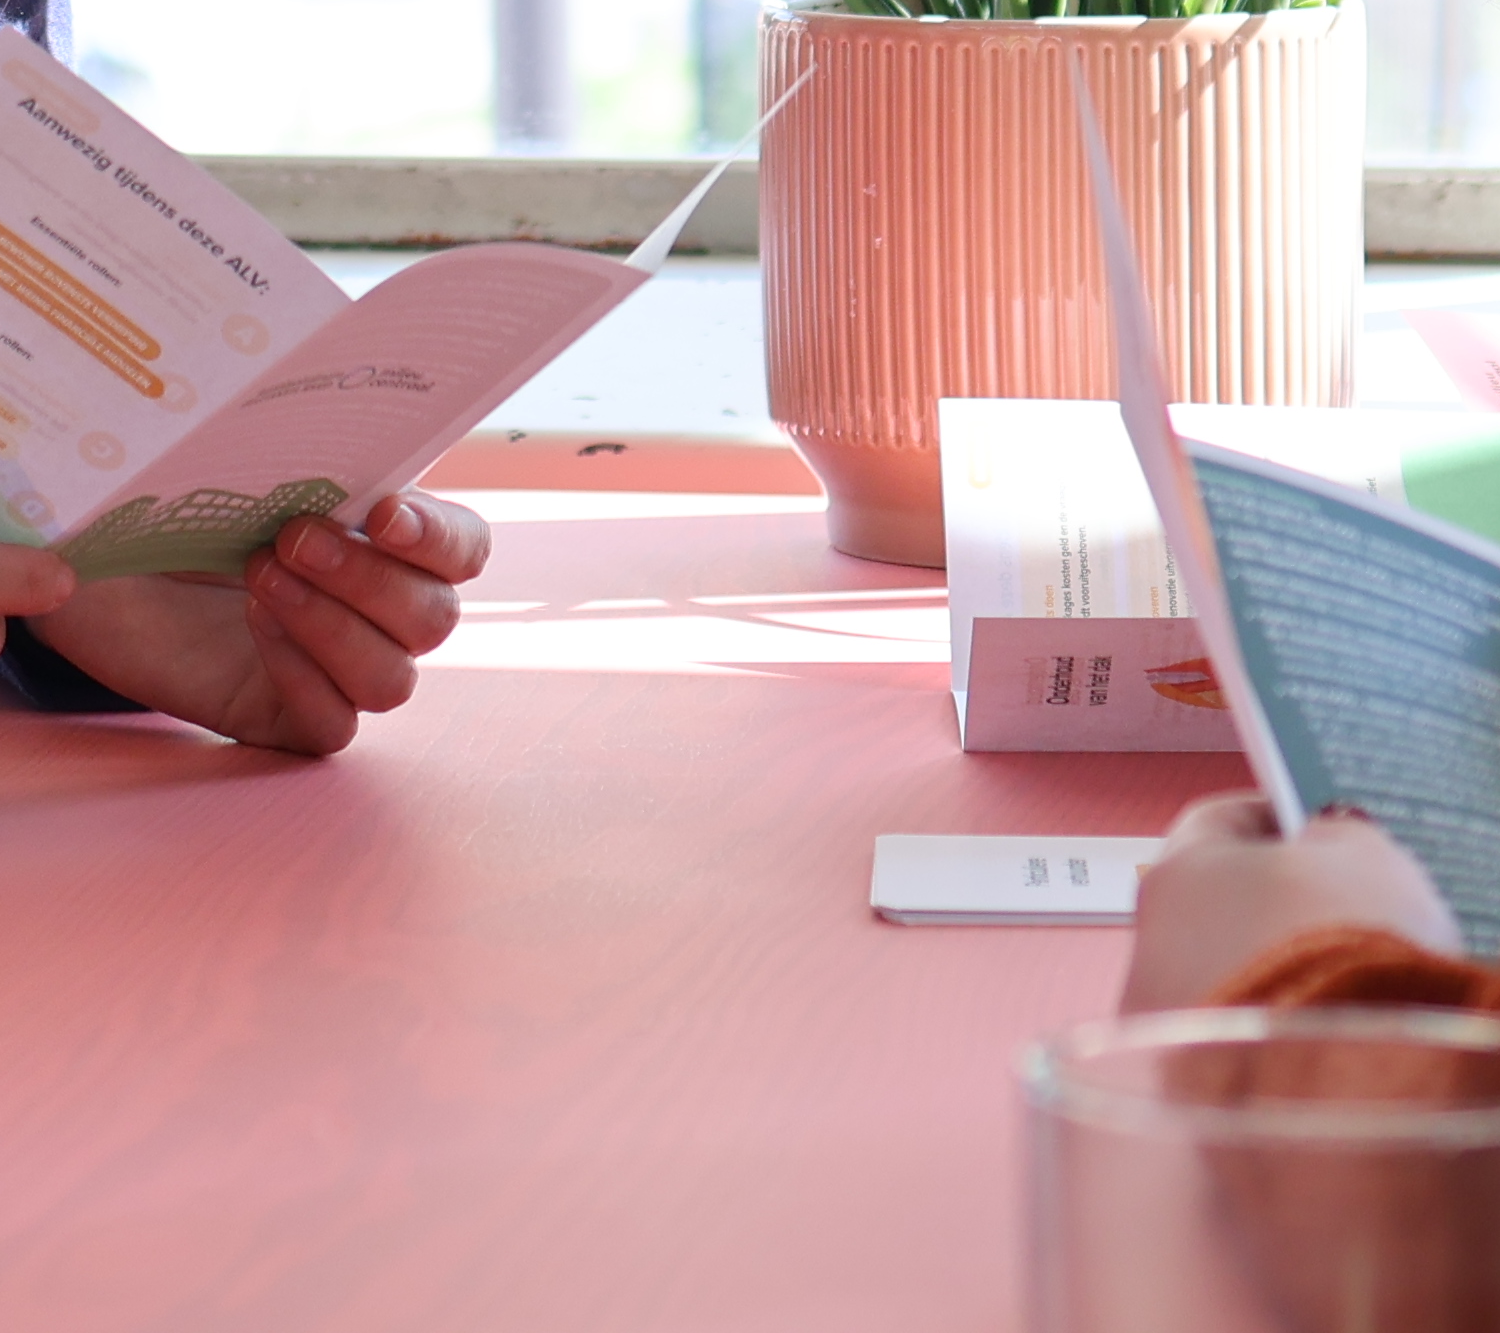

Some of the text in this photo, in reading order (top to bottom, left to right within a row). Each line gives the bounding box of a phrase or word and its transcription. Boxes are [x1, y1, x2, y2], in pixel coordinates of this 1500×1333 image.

[17, 97, 271, 295] Aanwezig tijdens deze ALV:
[1060, 525, 1068, 536] en
[1059, 537, 1072, 558] geld
[1061, 559, 1071, 589] kosten
[1078, 525, 1091, 606] vooruitgeschoven.
[1045, 585, 1054, 608] doen
[1063, 590, 1075, 618] kages
[1150, 586, 1161, 618] overen
[1166, 578, 1178, 618] enovatie
[1046, 656, 1075, 704] Onderhoud
[1085, 655, 1112, 706] van het dak
